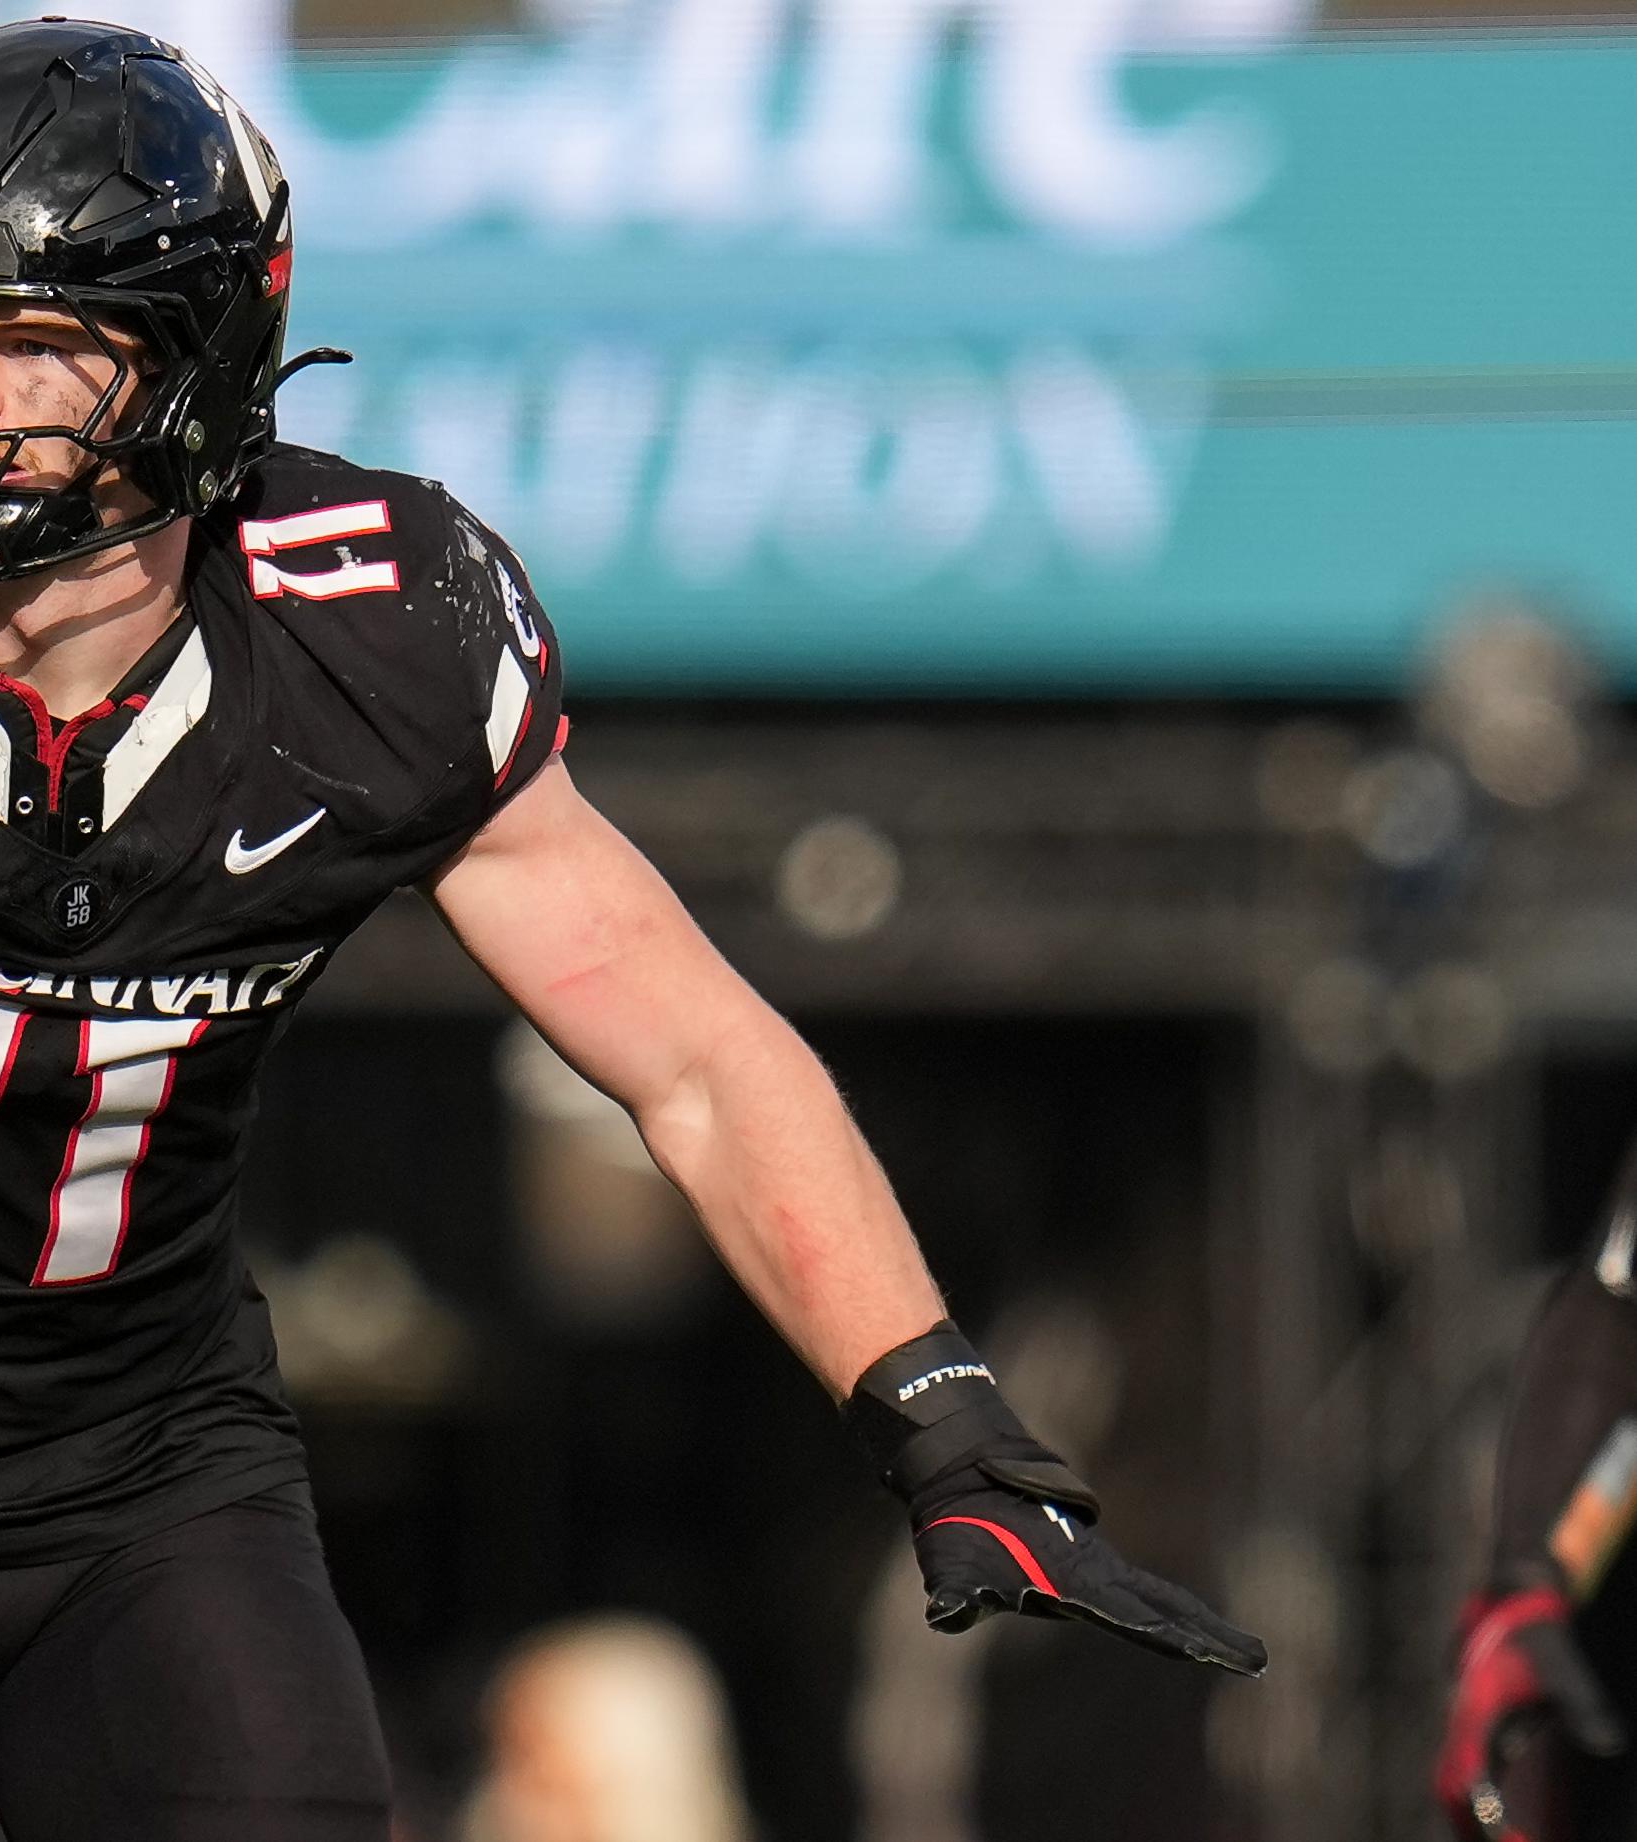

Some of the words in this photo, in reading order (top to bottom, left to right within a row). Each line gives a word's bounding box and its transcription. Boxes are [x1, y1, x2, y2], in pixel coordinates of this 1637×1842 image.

[239, 499, 401, 601] 11
[67, 885, 90, 907] JK
[66, 905, 91, 928] 58
